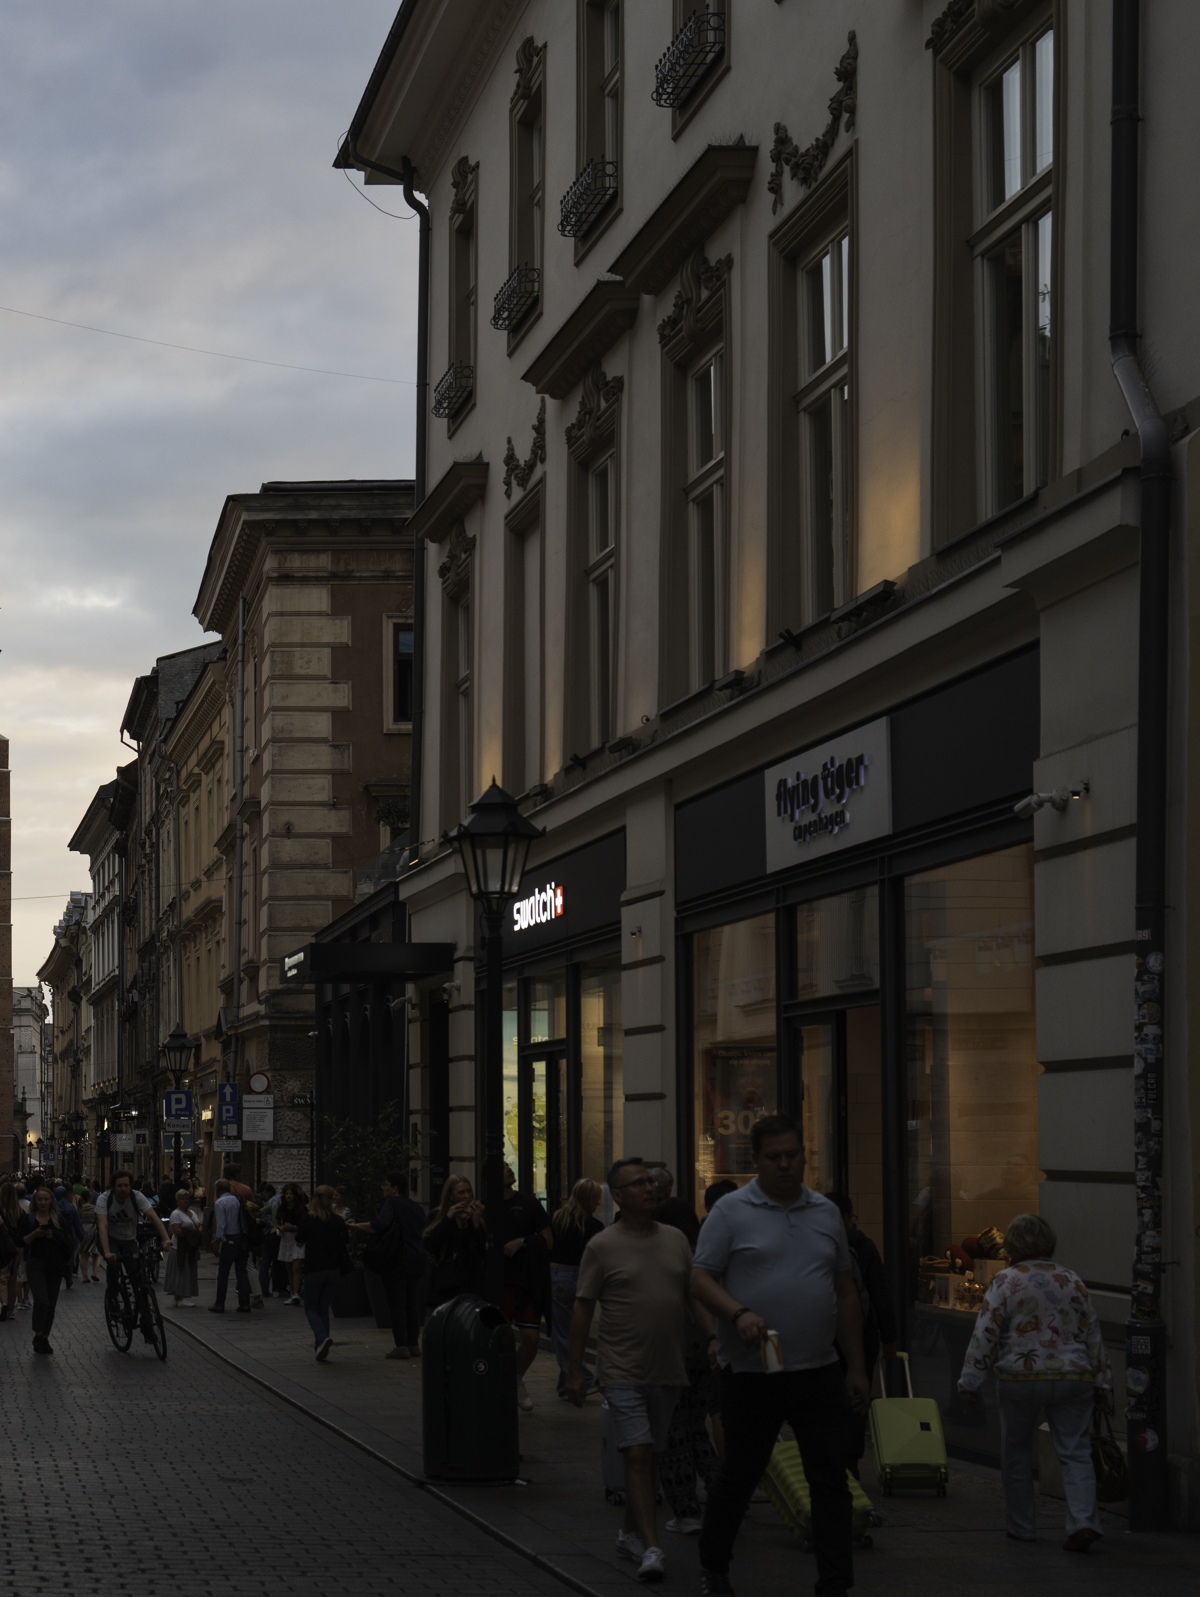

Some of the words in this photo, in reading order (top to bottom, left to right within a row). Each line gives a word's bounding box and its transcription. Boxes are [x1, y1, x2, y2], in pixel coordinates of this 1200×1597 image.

[776, 771, 821, 822] flying
[821, 754, 867, 804] tiger
[794, 810, 848, 842] copenhagen
[513, 882, 555, 931] swatch
[1147, 1072, 1157, 1104] FULCRO
[171, 1094, 187, 1115] P
[222, 1106, 234, 1121] P
